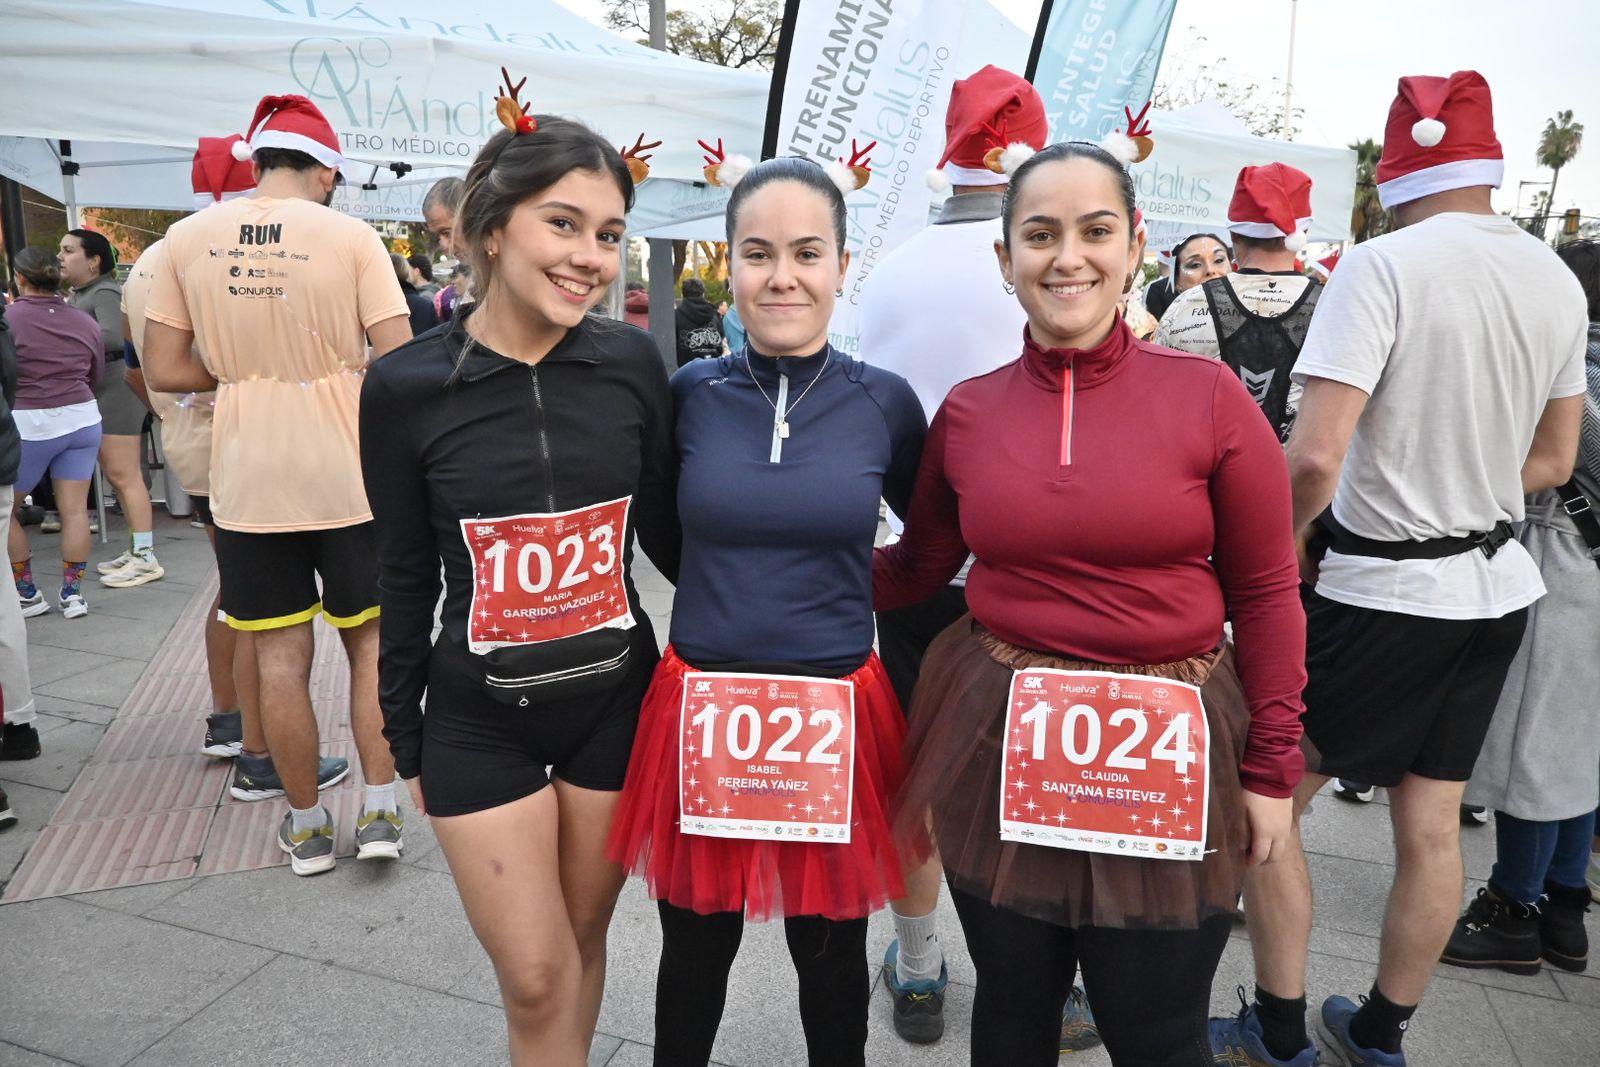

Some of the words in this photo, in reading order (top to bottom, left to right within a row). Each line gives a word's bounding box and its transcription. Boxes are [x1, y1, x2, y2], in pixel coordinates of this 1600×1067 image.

[1068, 29, 1116, 128] SALUD
[392, 133, 471, 157] MÉDICO
[878, 160, 909, 231] MÉDICO
[903, 46, 950, 154] DEPORTIVO
[1149, 201, 1211, 219] DEPORTIVO
[239, 223, 282, 245] RUN
[476, 525, 495, 536] 5K
[512, 525, 544, 535] Huelva
[484, 524, 616, 594] 1023
[503, 605, 557, 619] GARRIDO
[560, 590, 605, 612] VAZQUEZ
[543, 591, 572, 603] MARIA
[695, 681, 712, 692] 5K
[726, 685, 758, 695] Huelva
[1023, 676, 1045, 689] 5K
[1060, 683, 1097, 694] Huelva
[692, 703, 843, 765] 1022
[1020, 701, 1196, 774] 1024
[747, 765, 782, 775] ISABEL
[1081, 770, 1130, 784] CLAUDIA
[717, 777, 768, 790] PEREIRA
[770, 778, 809, 792] YAÑEZ
[1042, 781, 1104, 798] SANTANA
[1106, 788, 1166, 804] ESTEVEZ
